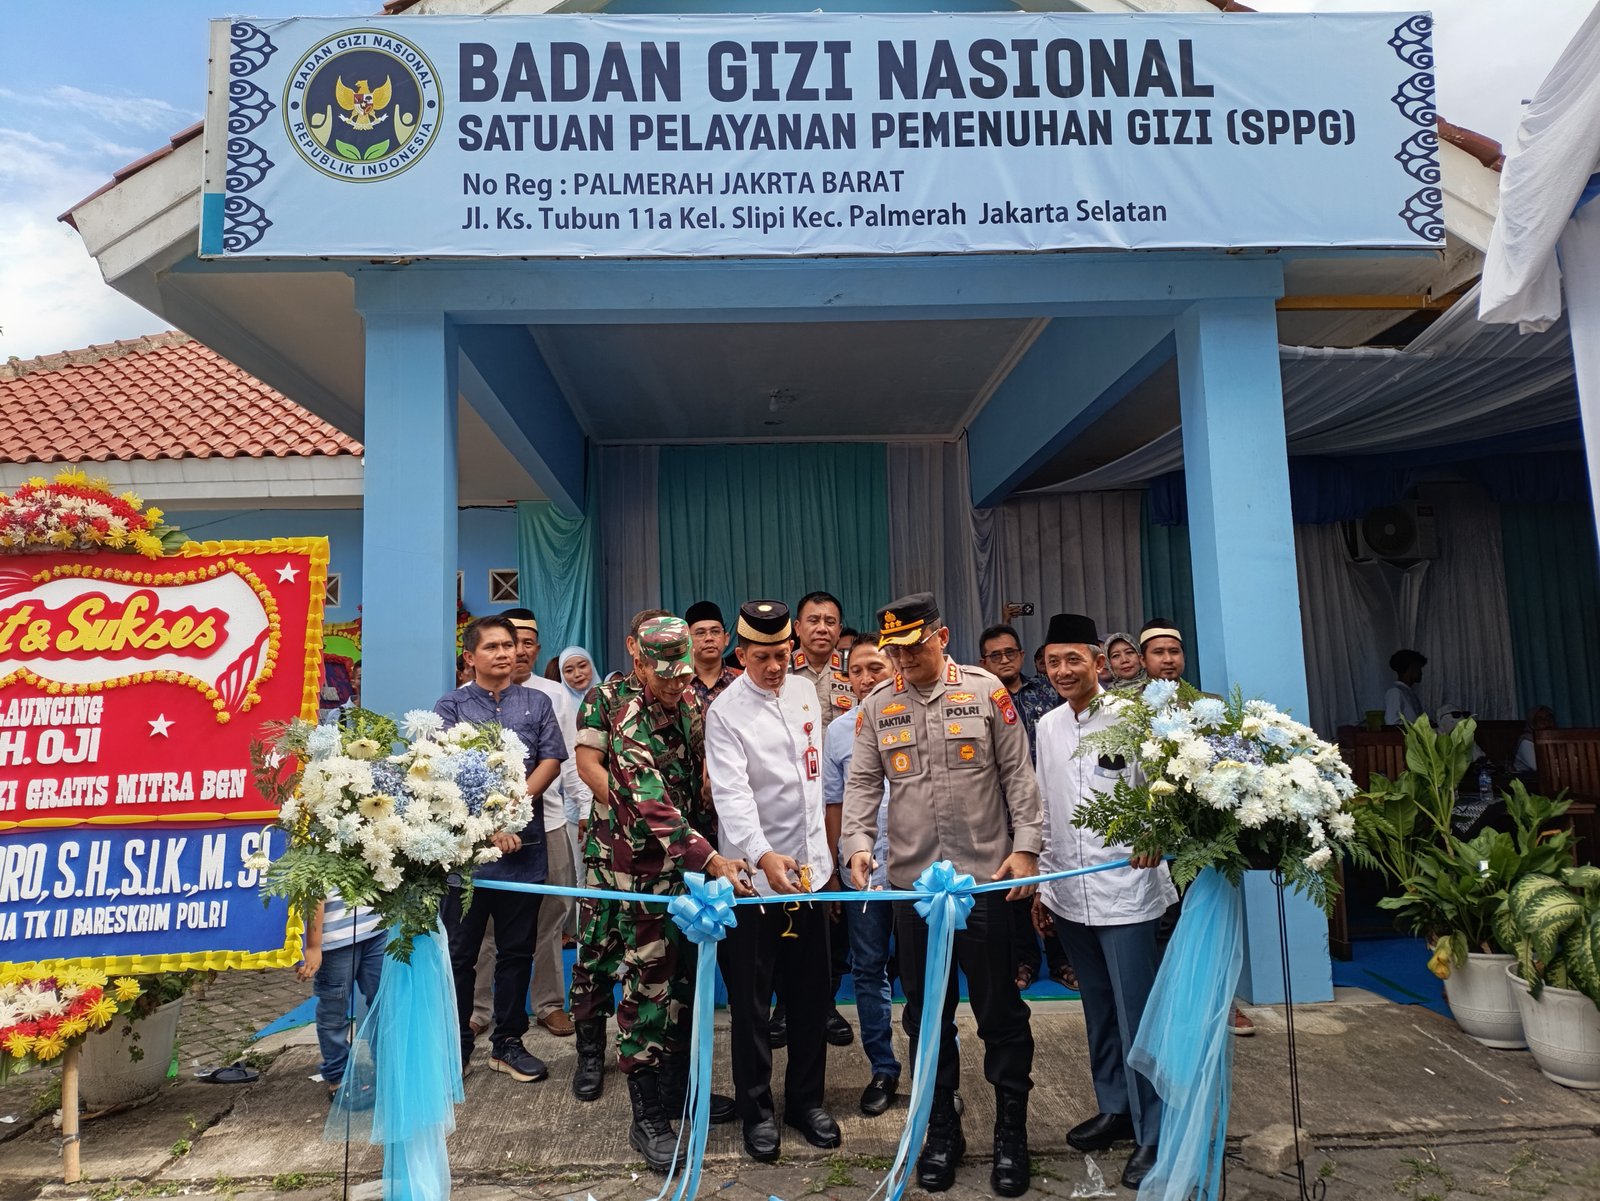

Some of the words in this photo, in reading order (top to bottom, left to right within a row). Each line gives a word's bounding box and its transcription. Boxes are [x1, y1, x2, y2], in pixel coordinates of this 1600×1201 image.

[294, 45, 333, 91] BADAN
[337, 35, 367, 50] GIZI
[372, 35, 433, 89] NASIONAL
[459, 42, 682, 103] BADAN
[707, 40, 853, 102] GIZI
[877, 37, 1215, 101] NASIONAL
[293, 122, 354, 175] REPUBLIK
[362, 122, 433, 176] INDONESIA
[458, 114, 614, 152] SATUAN
[629, 112, 857, 151] PELAYANAN
[871, 109, 1113, 149] PEMENUHAN
[1127, 108, 1213, 146] GIZI
[1226, 108, 1356, 146] (SPPG)
[463, 172, 498, 196] No
[573, 172, 713, 196] PALMERAH
[719, 171, 816, 197] JAKRTA
[822, 169, 905, 194] BARAT
[461, 206, 489, 232] Jl.
[496, 207, 533, 230] Ks.
[538, 206, 620, 230] Tubun
[628, 207, 672, 230] 11a
[679, 205, 726, 230] Kel.
[732, 205, 785, 235] Slipi
[792, 205, 843, 229] Kec.
[849, 202, 967, 227] Palmerah
[978, 200, 1069, 225] Jakarta
[1076, 199, 1167, 223] Selatan
[0, 605, 35, 653] t
[20, 619, 51, 652] &
[56, 595, 217, 652] Sukses
[878, 714, 912, 729] BAKTIAR
[946, 705, 980, 717] POLRI
[0, 730, 32, 766] H.
[36, 727, 102, 764] OJI
[25, 775, 109, 810] GRATIS
[115, 771, 194, 805] MITRA
[200, 768, 247, 799] BGN
[23, 910, 51, 940] TK
[53, 908, 68, 938] II
[70, 901, 173, 937] BARESKRIM
[176, 900, 229, 930] POLRI
